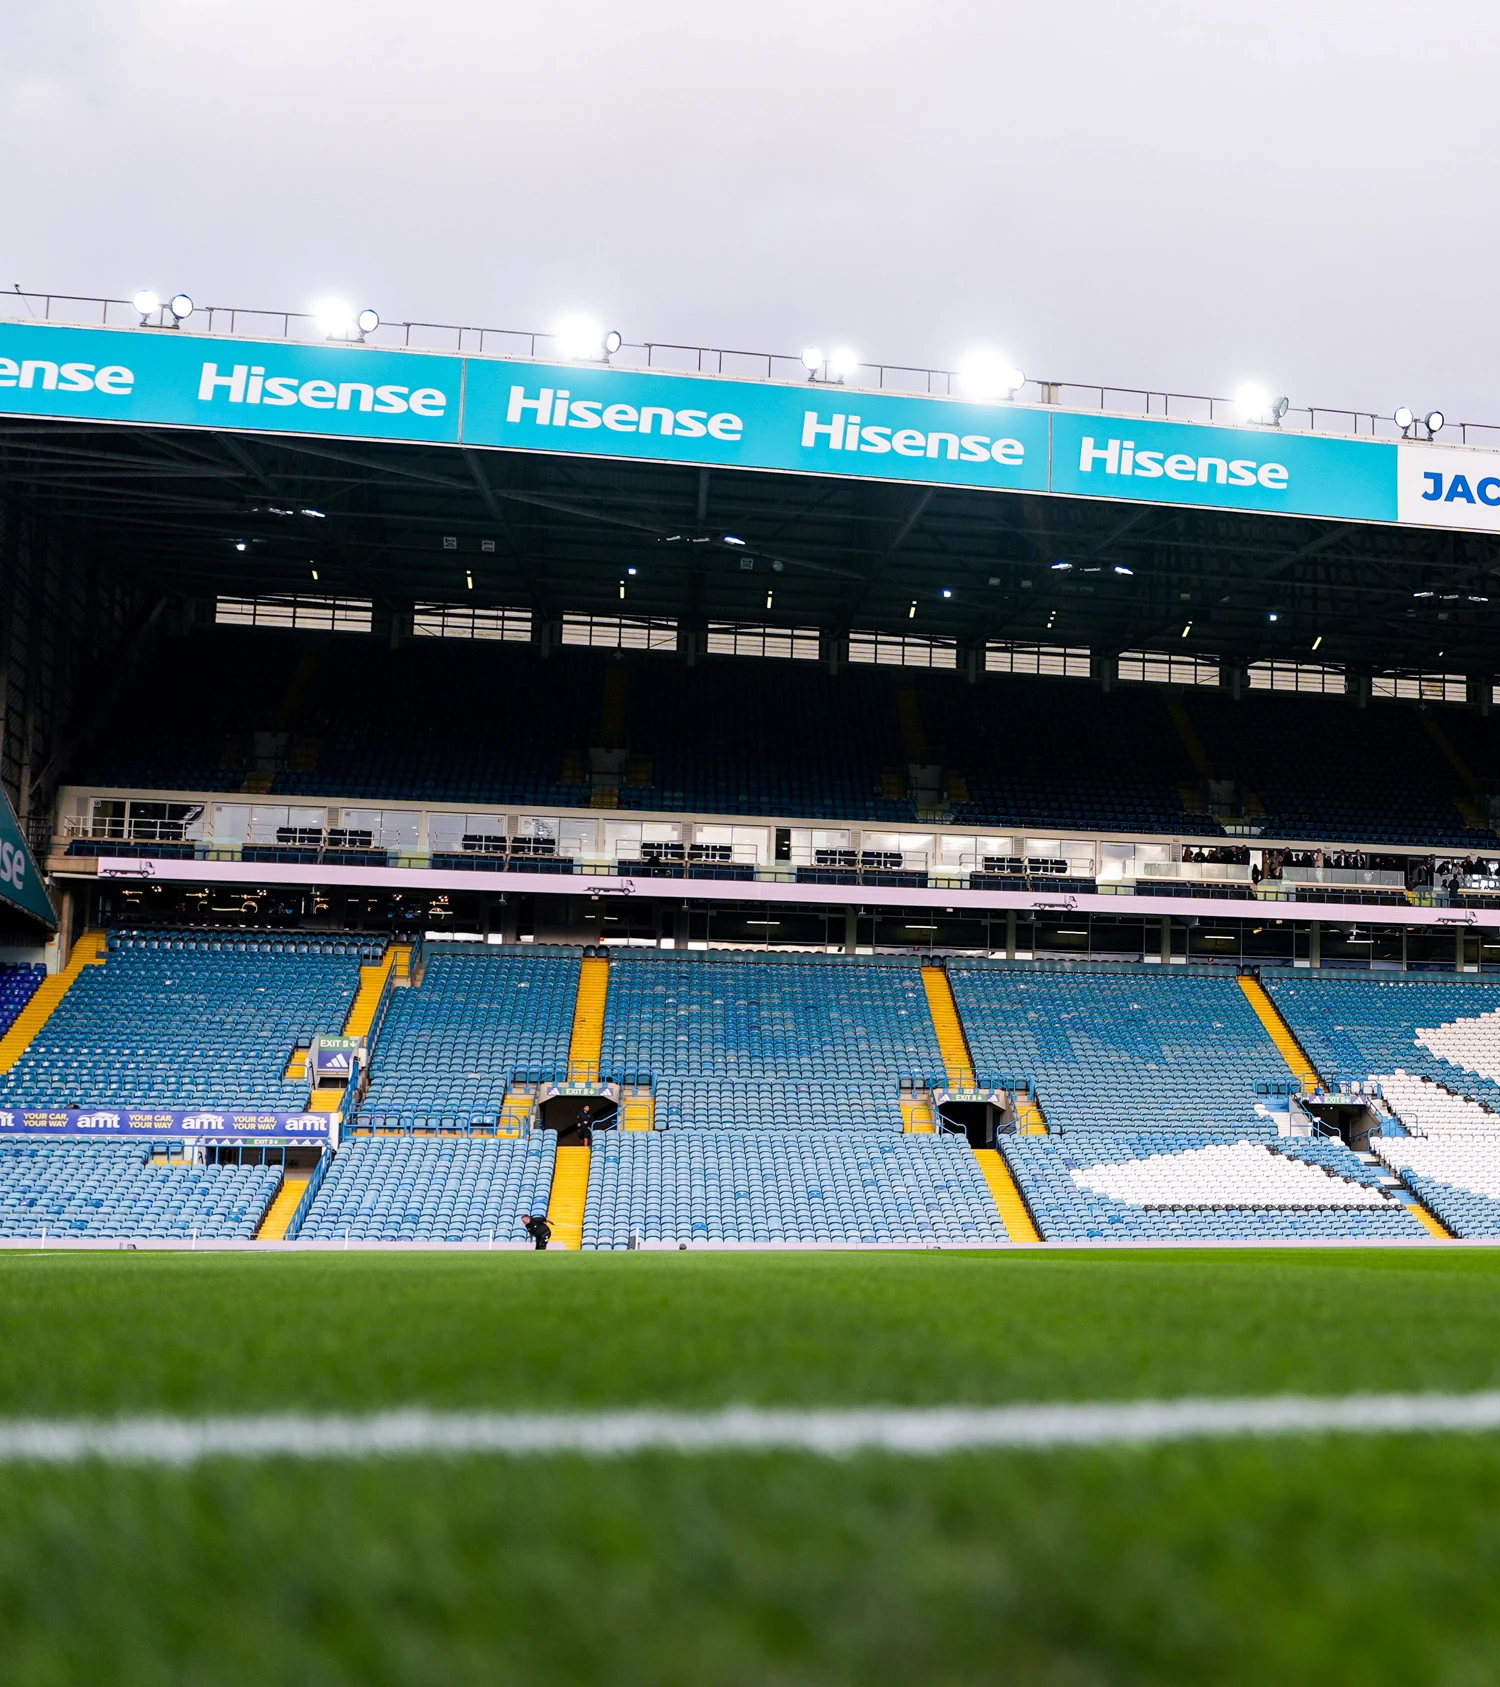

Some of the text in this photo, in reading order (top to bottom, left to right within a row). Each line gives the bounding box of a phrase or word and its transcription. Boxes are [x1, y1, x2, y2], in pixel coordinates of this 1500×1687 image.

[198, 363, 446, 416] Hisense
[507, 386, 743, 440] Hisense
[802, 411, 1024, 465] Hisense
[1080, 437, 1289, 489] Hisense
[0, 838, 25, 890] se
[320, 1040, 341, 1048] EXIT
[23, 1112, 46, 1120] YOUR
[49, 1112, 69, 1121] CAR,
[77, 1112, 120, 1128] amt
[154, 1114, 174, 1123] CAR,
[182, 1114, 224, 1130] amt
[258, 1116, 278, 1124] CAR,
[285, 1115, 328, 1131] amt
